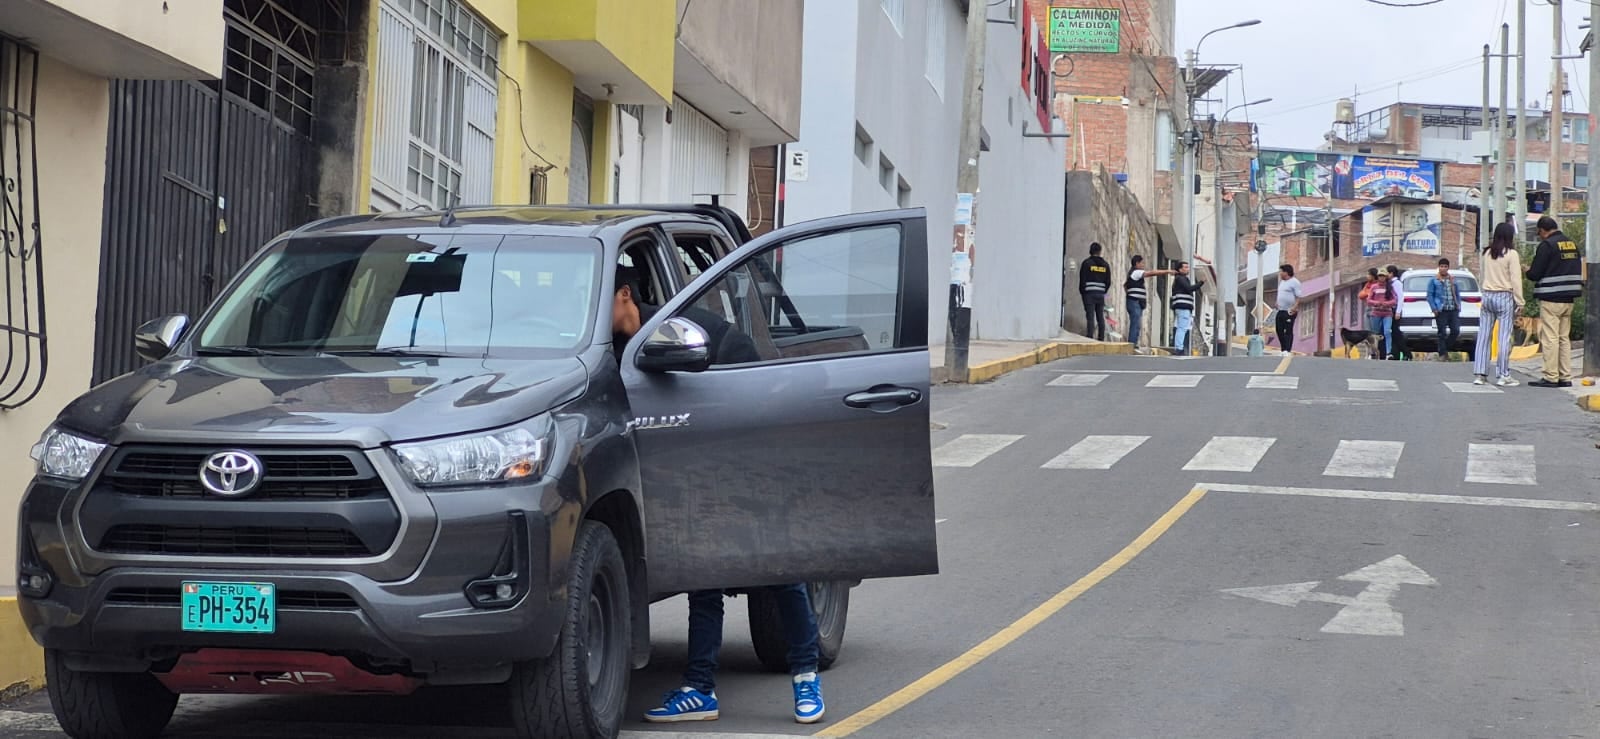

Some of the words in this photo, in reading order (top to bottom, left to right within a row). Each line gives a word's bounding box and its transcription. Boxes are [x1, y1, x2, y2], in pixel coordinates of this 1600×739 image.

[1069, 21, 1111, 29] MEDIDA
[1385, 169, 1407, 181] DEL
[211, 585, 244, 595] PERU
[188, 605, 195, 623] E
[199, 596, 270, 625] PH-354
